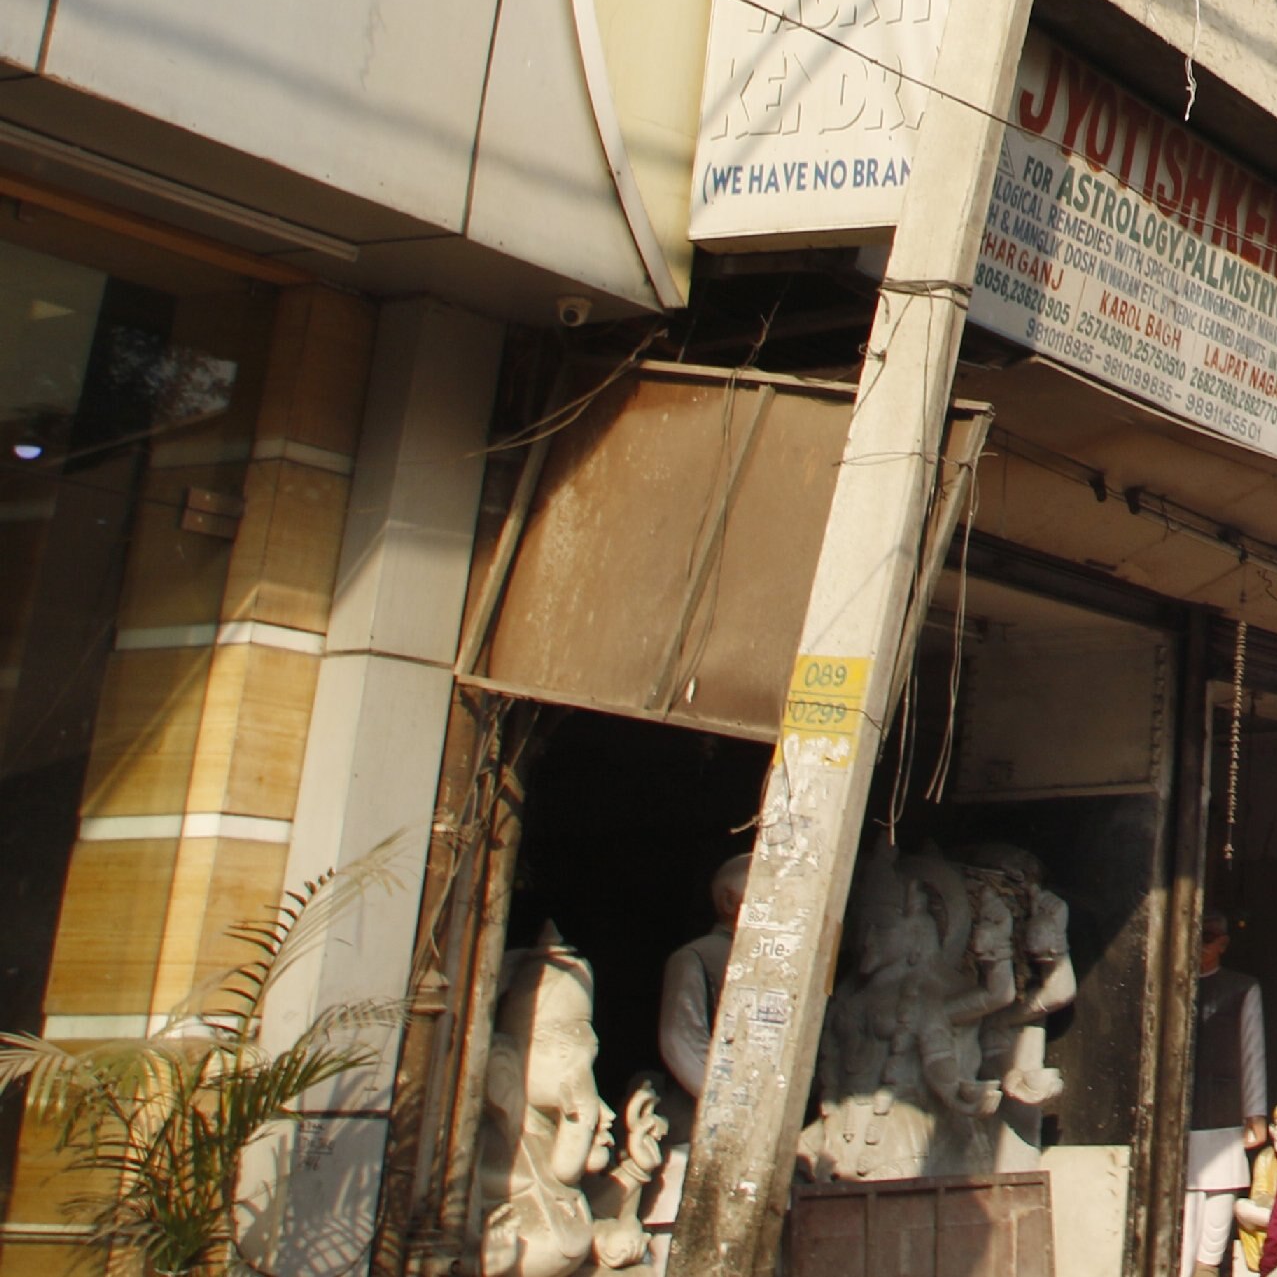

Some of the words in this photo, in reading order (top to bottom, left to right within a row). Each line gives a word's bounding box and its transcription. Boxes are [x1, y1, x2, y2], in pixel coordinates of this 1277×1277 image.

[747, 160, 808, 195] HAVE
[811, 158, 847, 191] NO
[1021, 153, 1054, 196] FOR
[991, 173, 1044, 222] LOGICAL
[1046, 202, 1113, 258] REMEDIES
[1112, 238, 1145, 275] WITH
[1142, 256, 1181, 296] SPECIAL
[999, 208, 1012, 235] &
[1011, 215, 1064, 263] MANGLIK
[1063, 242, 1097, 279] DOSH
[1098, 288, 1143, 334] KAROL
[1145, 312, 1183, 353] BAGH
[1202, 341, 1249, 385] LAJPAT
[804, 661, 848, 688] 089
[790, 699, 848, 725] 0299
